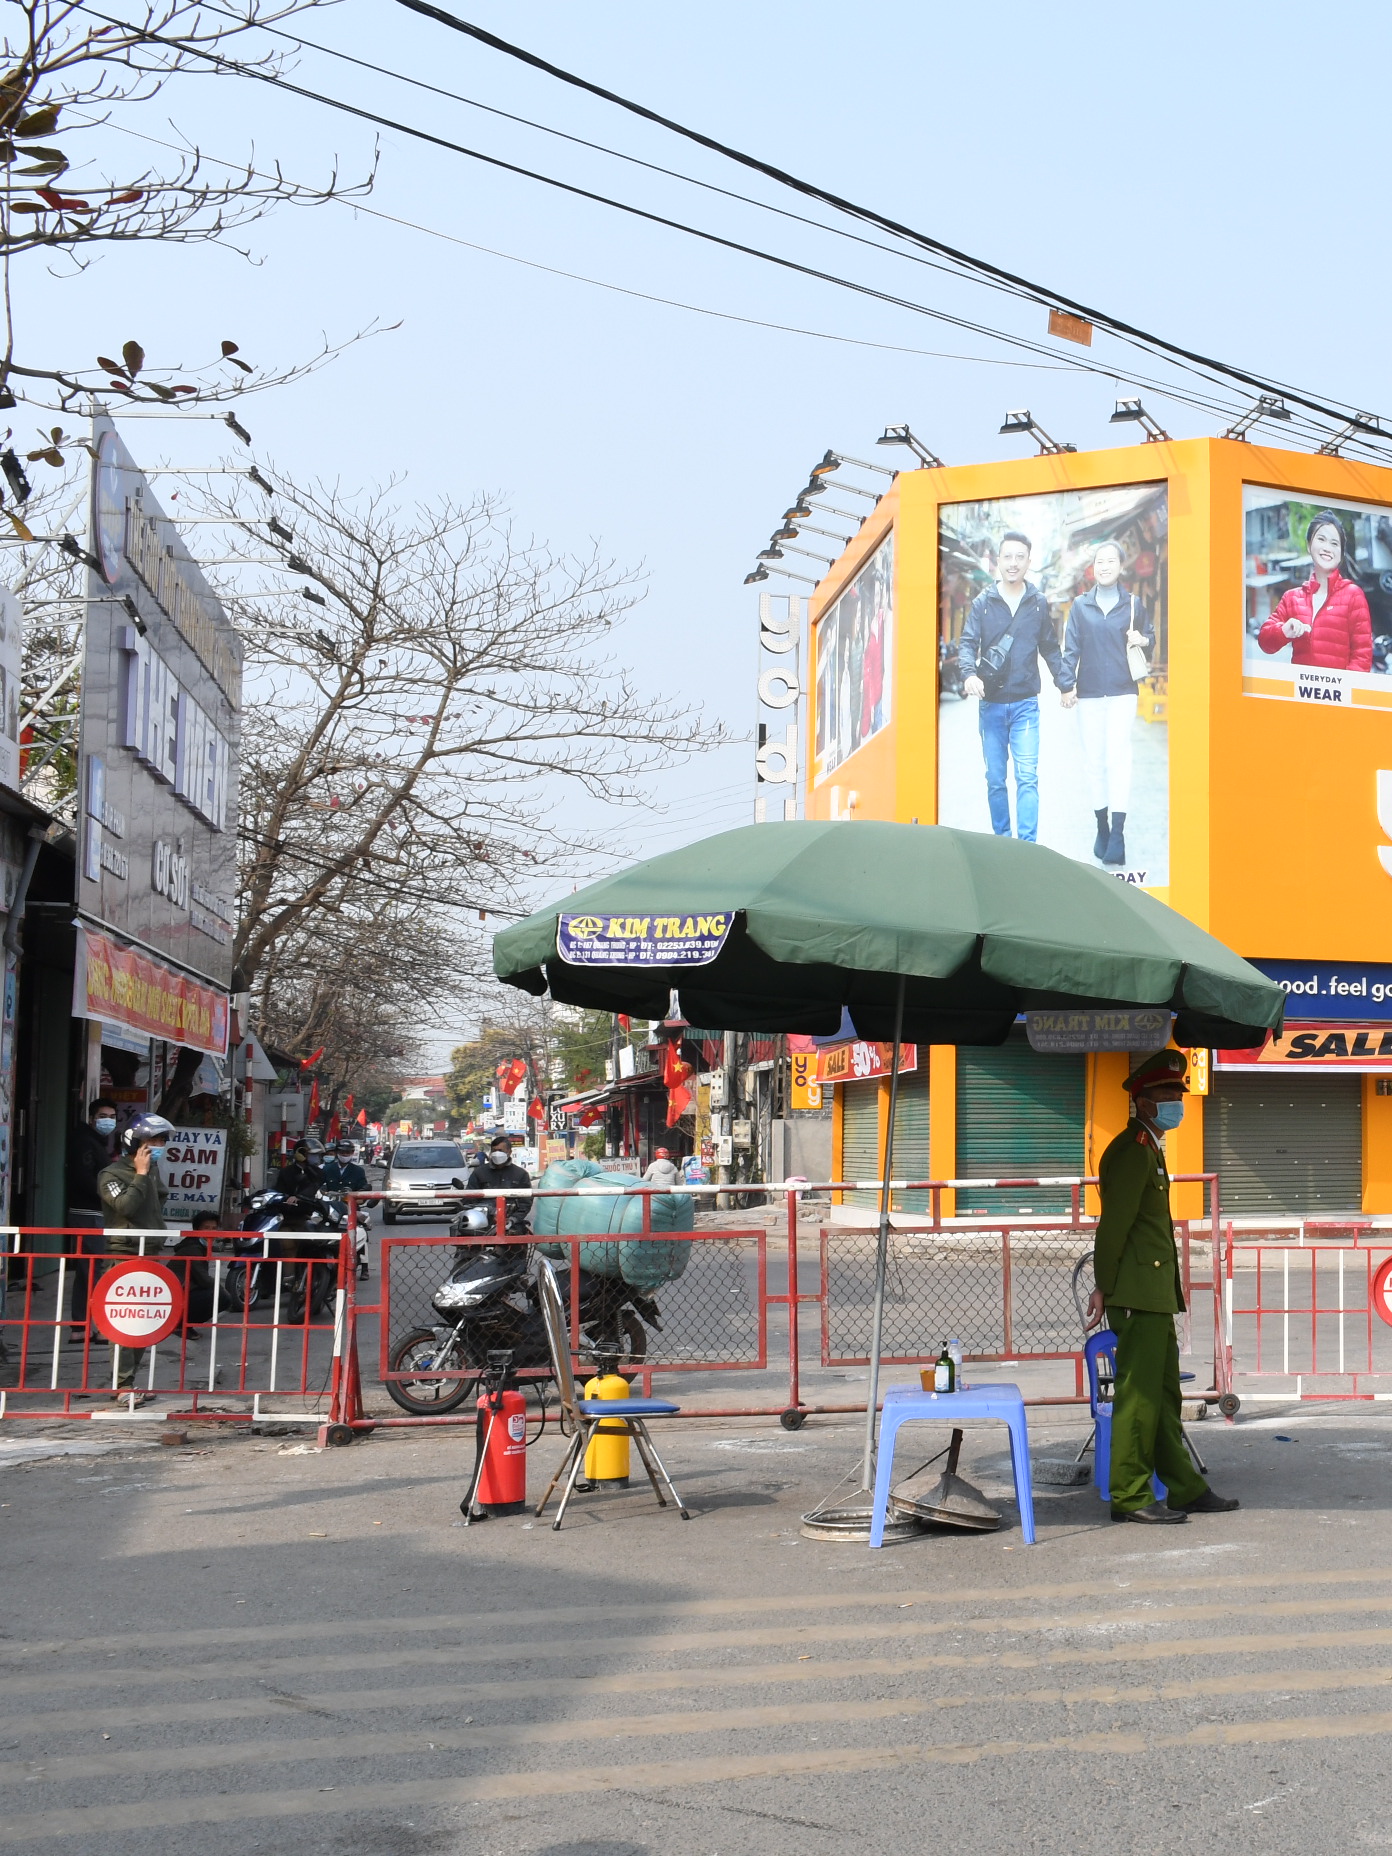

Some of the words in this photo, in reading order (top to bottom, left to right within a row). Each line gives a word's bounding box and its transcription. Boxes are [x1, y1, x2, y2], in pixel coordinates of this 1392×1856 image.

[1300, 673, 1342, 684] EVERYDAY
[1299, 686, 1342, 702] WEAR
[121, 625, 177, 785] THE
[176, 692, 229, 833] MEN
[606, 918, 650, 938] KIM
[653, 915, 726, 938] TRANG
[827, 1049, 846, 1076] SALE
[850, 1041, 880, 1077] -50%
[204, 1131, 221, 1145] VÁ
[166, 1145, 217, 1165] SĂM
[168, 1169, 210, 1190] LỐP
[183, 1191, 218, 1203] MÁY
[115, 1286, 163, 1298] CAHP
